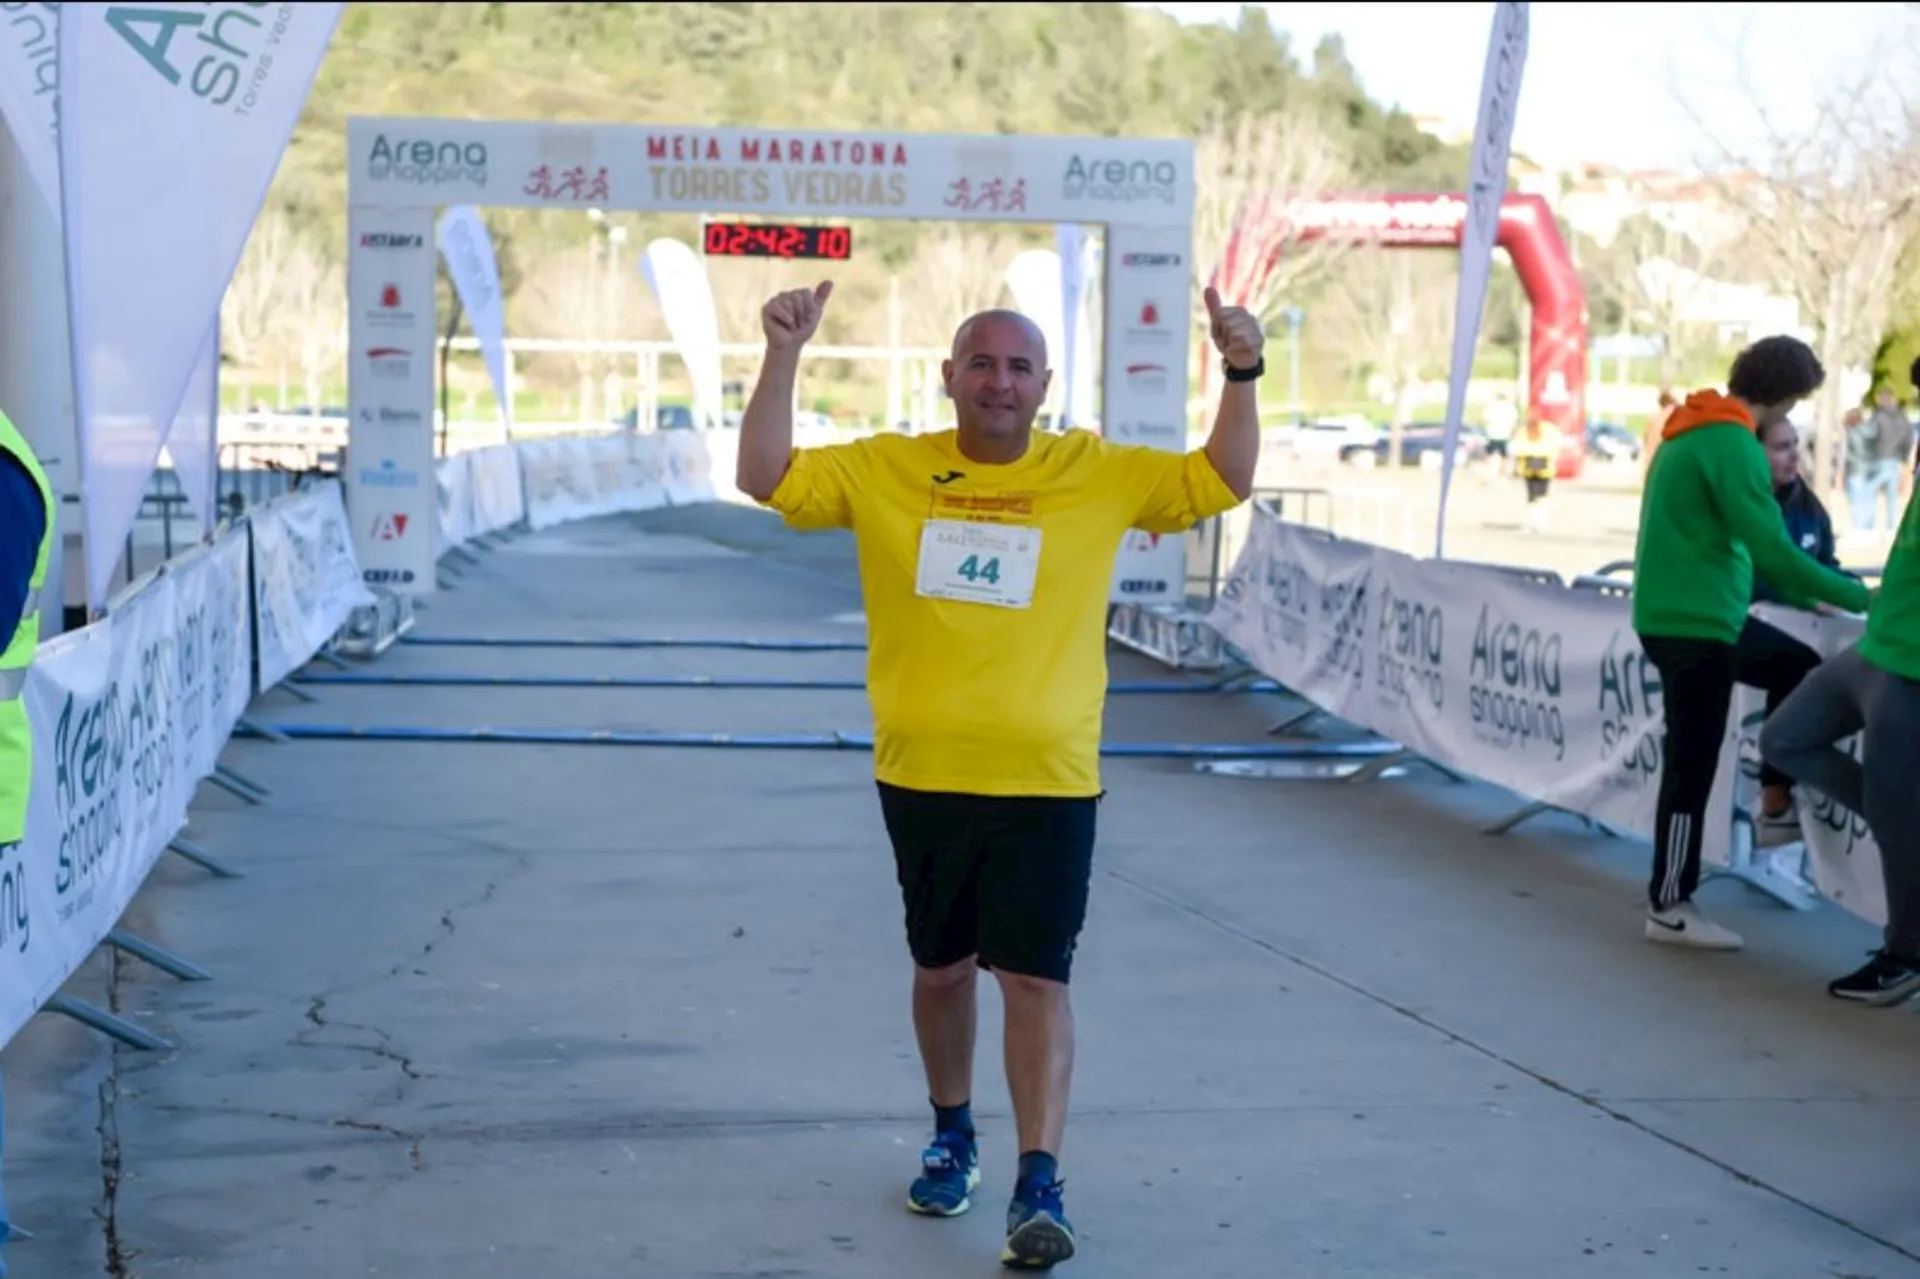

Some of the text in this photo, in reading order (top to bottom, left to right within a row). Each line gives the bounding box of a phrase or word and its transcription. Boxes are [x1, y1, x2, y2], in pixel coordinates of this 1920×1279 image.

[368, 132, 487, 166] Arena
[647, 135, 908, 166] MEIA MARATONA
[648, 165, 907, 207] TORRES VEDRAS
[1062, 152, 1177, 187] Arena
[706, 222, 850, 259] 02:42:10
[957, 554, 1001, 585] 44
[1470, 603, 1562, 698] Arena
[1598, 628, 1665, 718] Are
[1470, 684, 1565, 762] shopping
